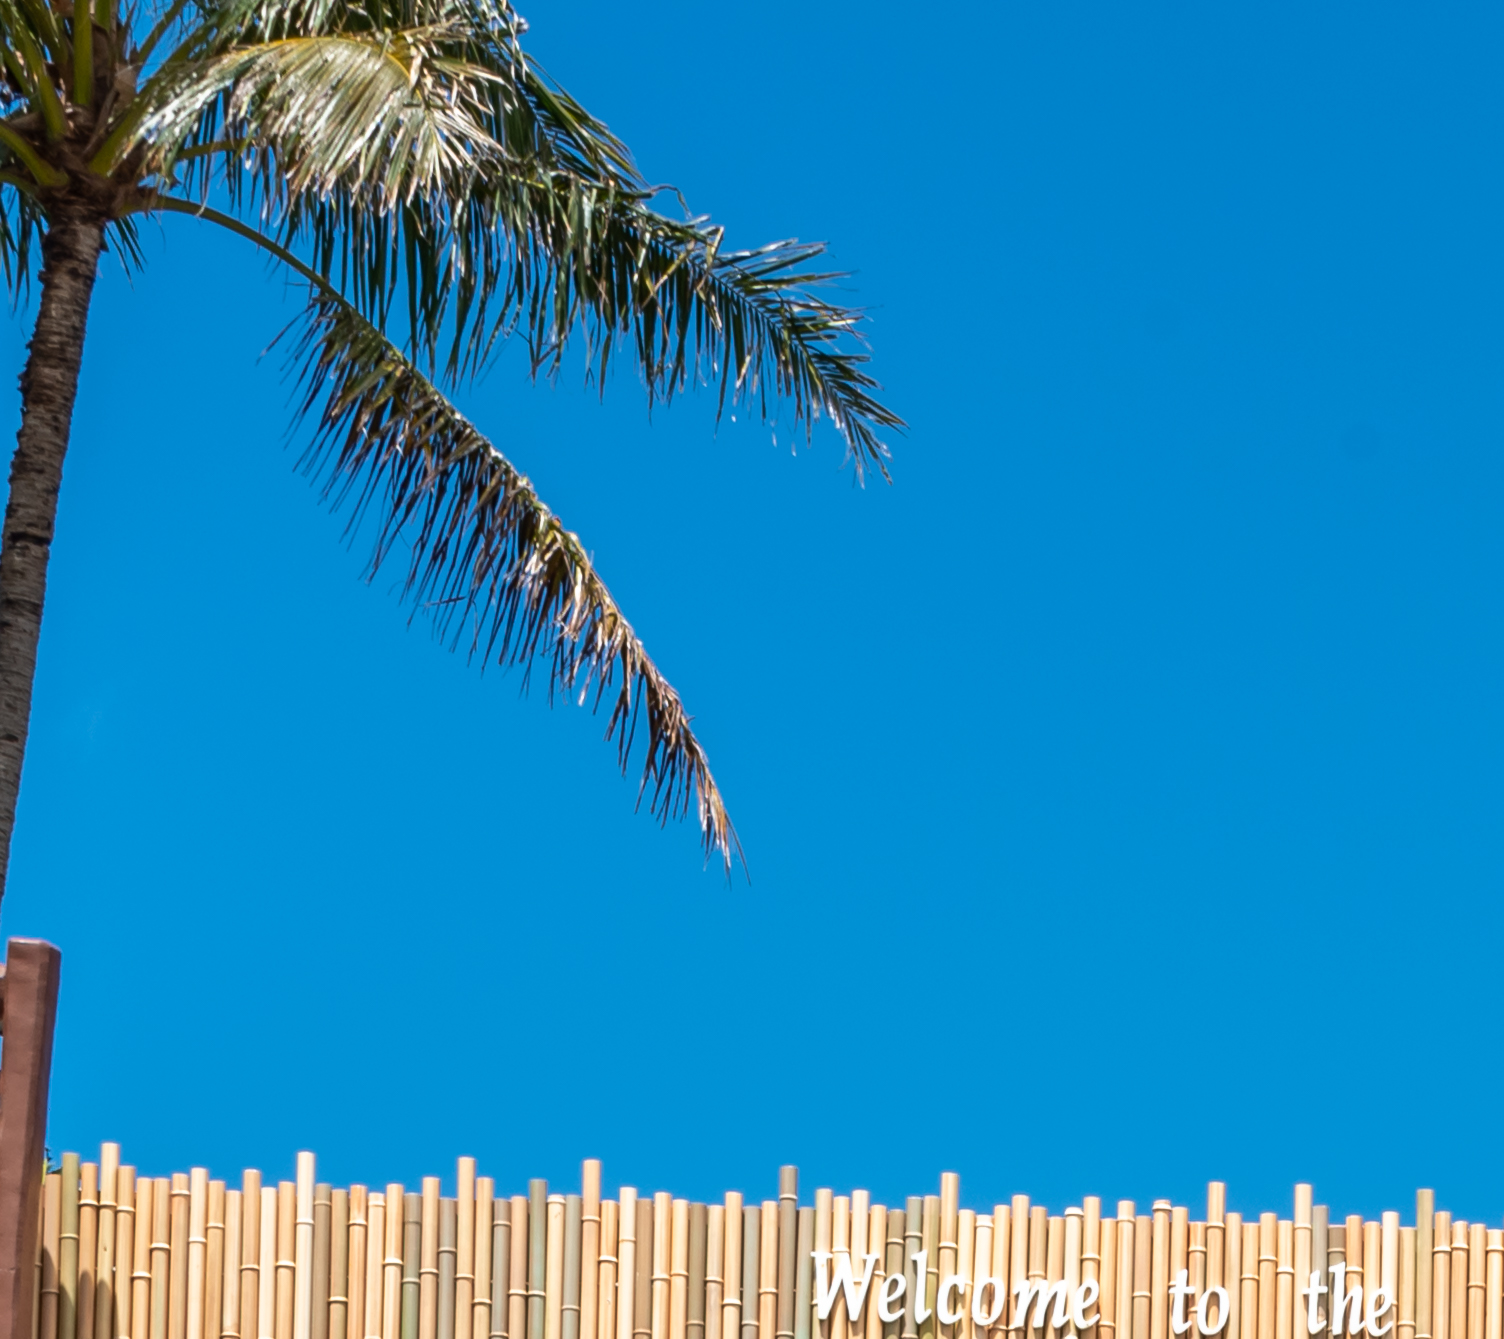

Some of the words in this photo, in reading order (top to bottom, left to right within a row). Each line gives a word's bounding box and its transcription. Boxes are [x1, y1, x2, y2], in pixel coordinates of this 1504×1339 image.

[811, 1250, 1101, 1330] Welcome
[1169, 1269, 1231, 1336] to
[1302, 1261, 1396, 1338] the
